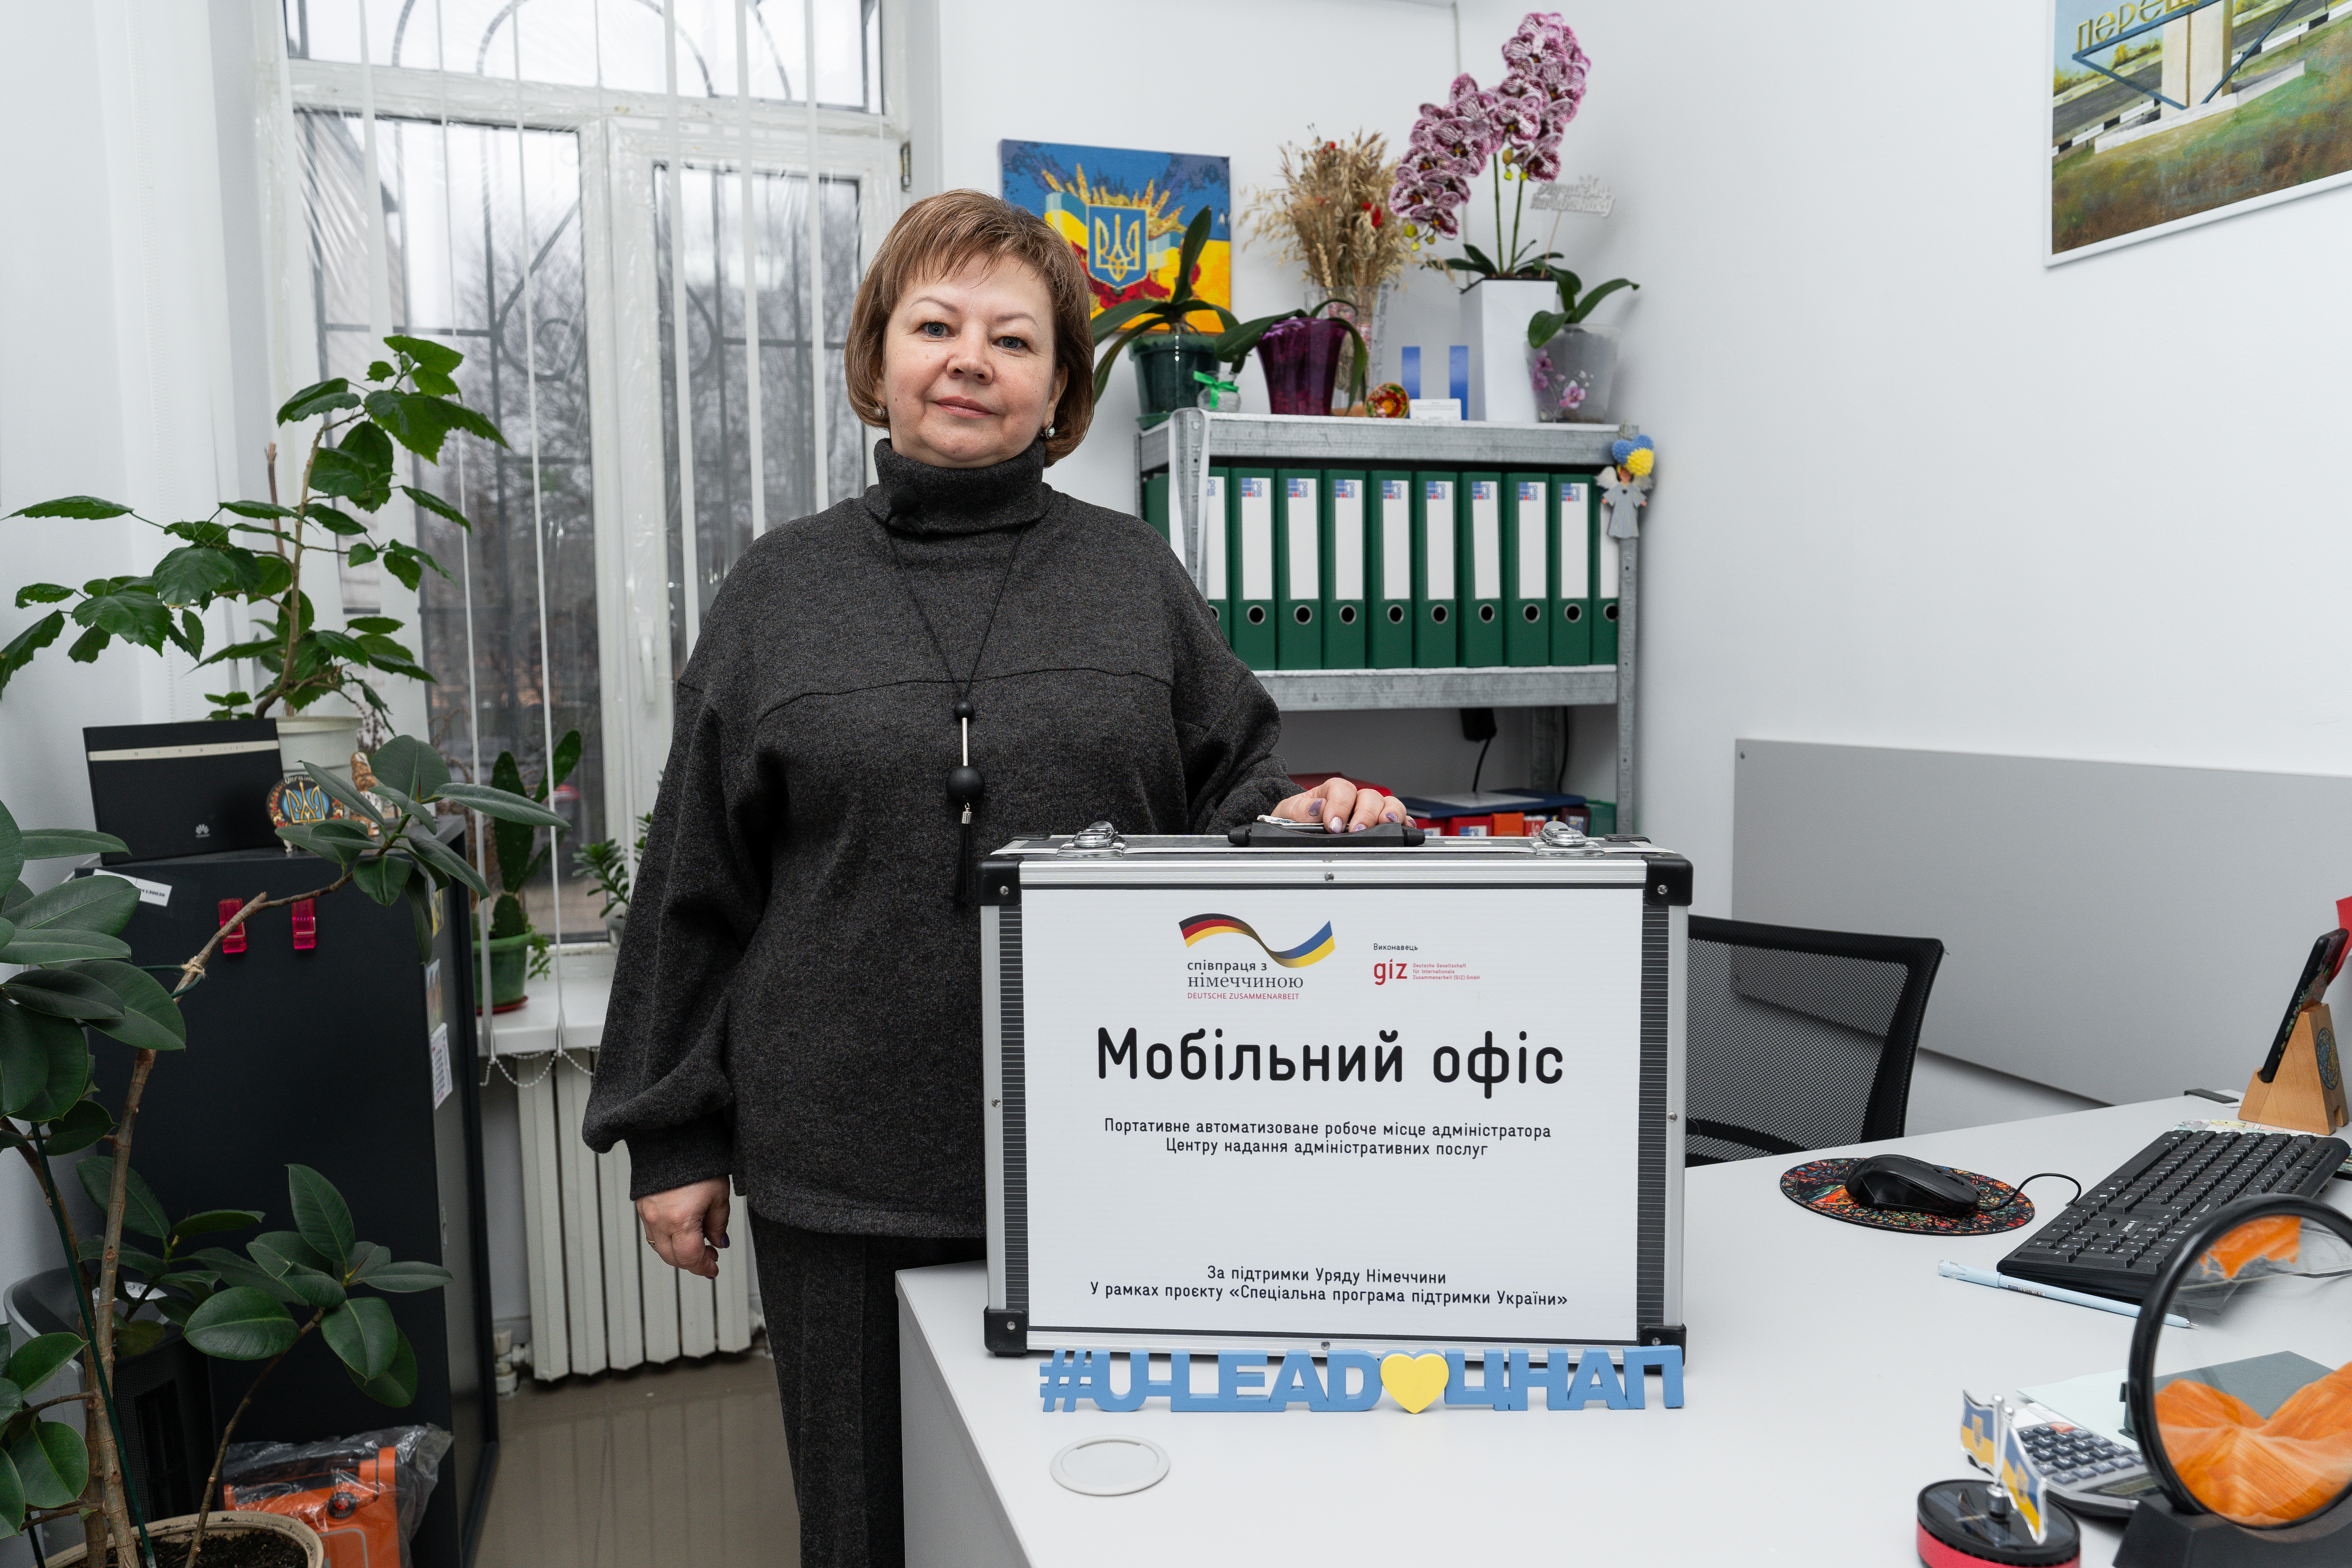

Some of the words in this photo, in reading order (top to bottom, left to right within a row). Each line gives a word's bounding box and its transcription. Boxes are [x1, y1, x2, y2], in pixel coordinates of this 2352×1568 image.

[1188, 959, 1256, 973] співпраця
[1374, 958, 1408, 985] giz
[1188, 973, 1304, 988] німеччиною
[1098, 1027, 1403, 1082] Мобільний
[1433, 1031, 1563, 1100] офіс
[1105, 1118, 1189, 1135] Портативне
[1197, 1123, 1318, 1134] автоматизоване
[1326, 1121, 1376, 1138] робоче
[1384, 1122, 1425, 1138] місце
[1433, 1123, 1551, 1141] адміністратора
[1167, 1138, 1218, 1155] Центру
[1225, 1142, 1287, 1155] надання
[1295, 1140, 1429, 1157] адміністративних
[1437, 1145, 1488, 1159] послуг
[1208, 1266, 1225, 1279] За
[1232, 1266, 1308, 1284] підтримки
[1316, 1268, 1360, 1286] Уряду
[1367, 1269, 1445, 1284] Німеччини
[1091, 1281, 1098, 1294] У
[1106, 1286, 1158, 1299] рамках
[1166, 1287, 1223, 1301] проєкту
[1230, 1285, 1326, 1301] «Спеціальна
[1333, 1291, 1404, 1305] програма
[1412, 1289, 1490, 1307] підтримки
[1497, 1291, 1567, 1308] України»
[1040, 1348, 1382, 1413] #U-LEAD
[1445, 1346, 1685, 1412] ЦНАП
